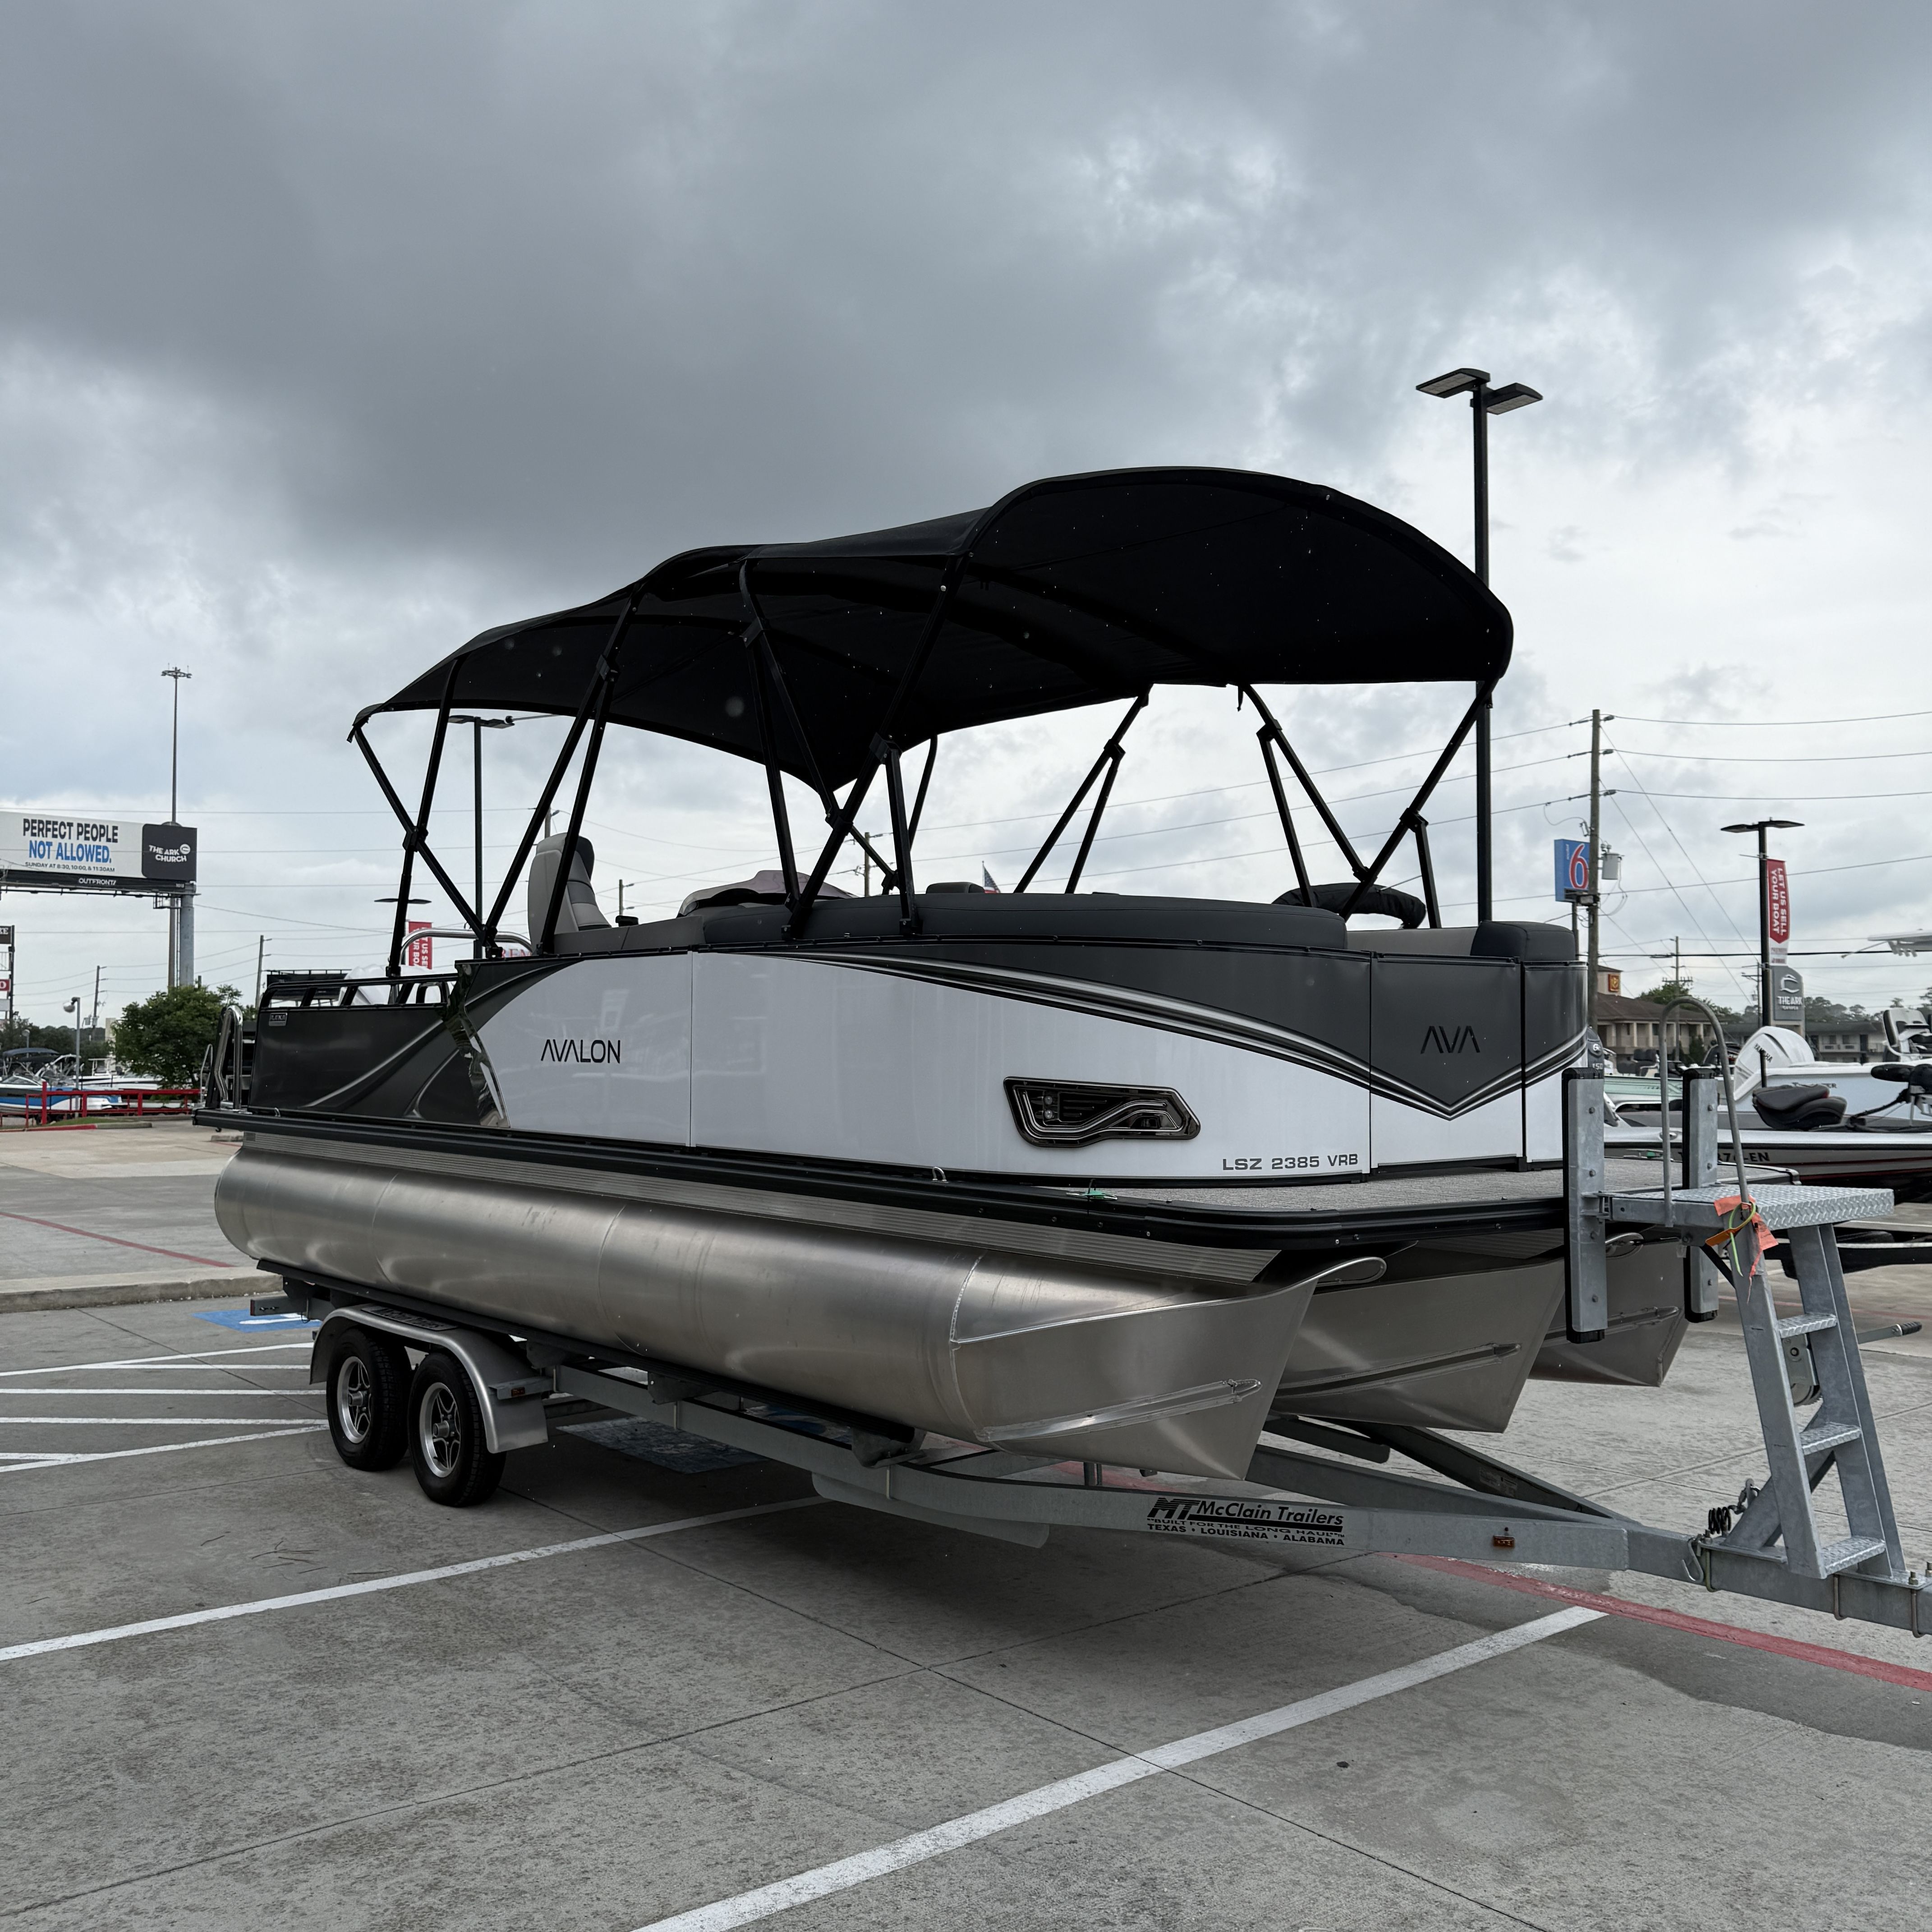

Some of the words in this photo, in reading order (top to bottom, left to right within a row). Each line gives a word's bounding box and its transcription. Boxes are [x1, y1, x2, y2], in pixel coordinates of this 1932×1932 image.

[23, 819, 74, 840] PERFECT
[77, 823, 119, 843] PEOPLE
[29, 840, 53, 859] NOT
[55, 842, 111, 863] ALLOWED.
[149, 845, 164, 854] THE
[155, 854, 187, 862] CHURCH
[1569, 843, 1589, 890] 6
[1780, 891, 1786, 906] US
[421, 943, 428, 954] US
[1777, 996, 1790, 1005] THE
[1790, 996, 1803, 1005] ARK
[541, 1039, 621, 1064] AVALON
[1223, 1158, 1262, 1171] LSZ
[1271, 1156, 1320, 1169] 2385
[1327, 1154, 1358, 1166] VRB
[1147, 1497, 1201, 1520] MT
[1196, 1500, 1271, 1519] McClain
[1278, 1506, 1344, 1525] Trailers
[1147, 1524, 1187, 1532] TEXAS
[1201, 1527, 1269, 1539] LOUISIANA
[1283, 1535, 1345, 1546] ALABAMA
